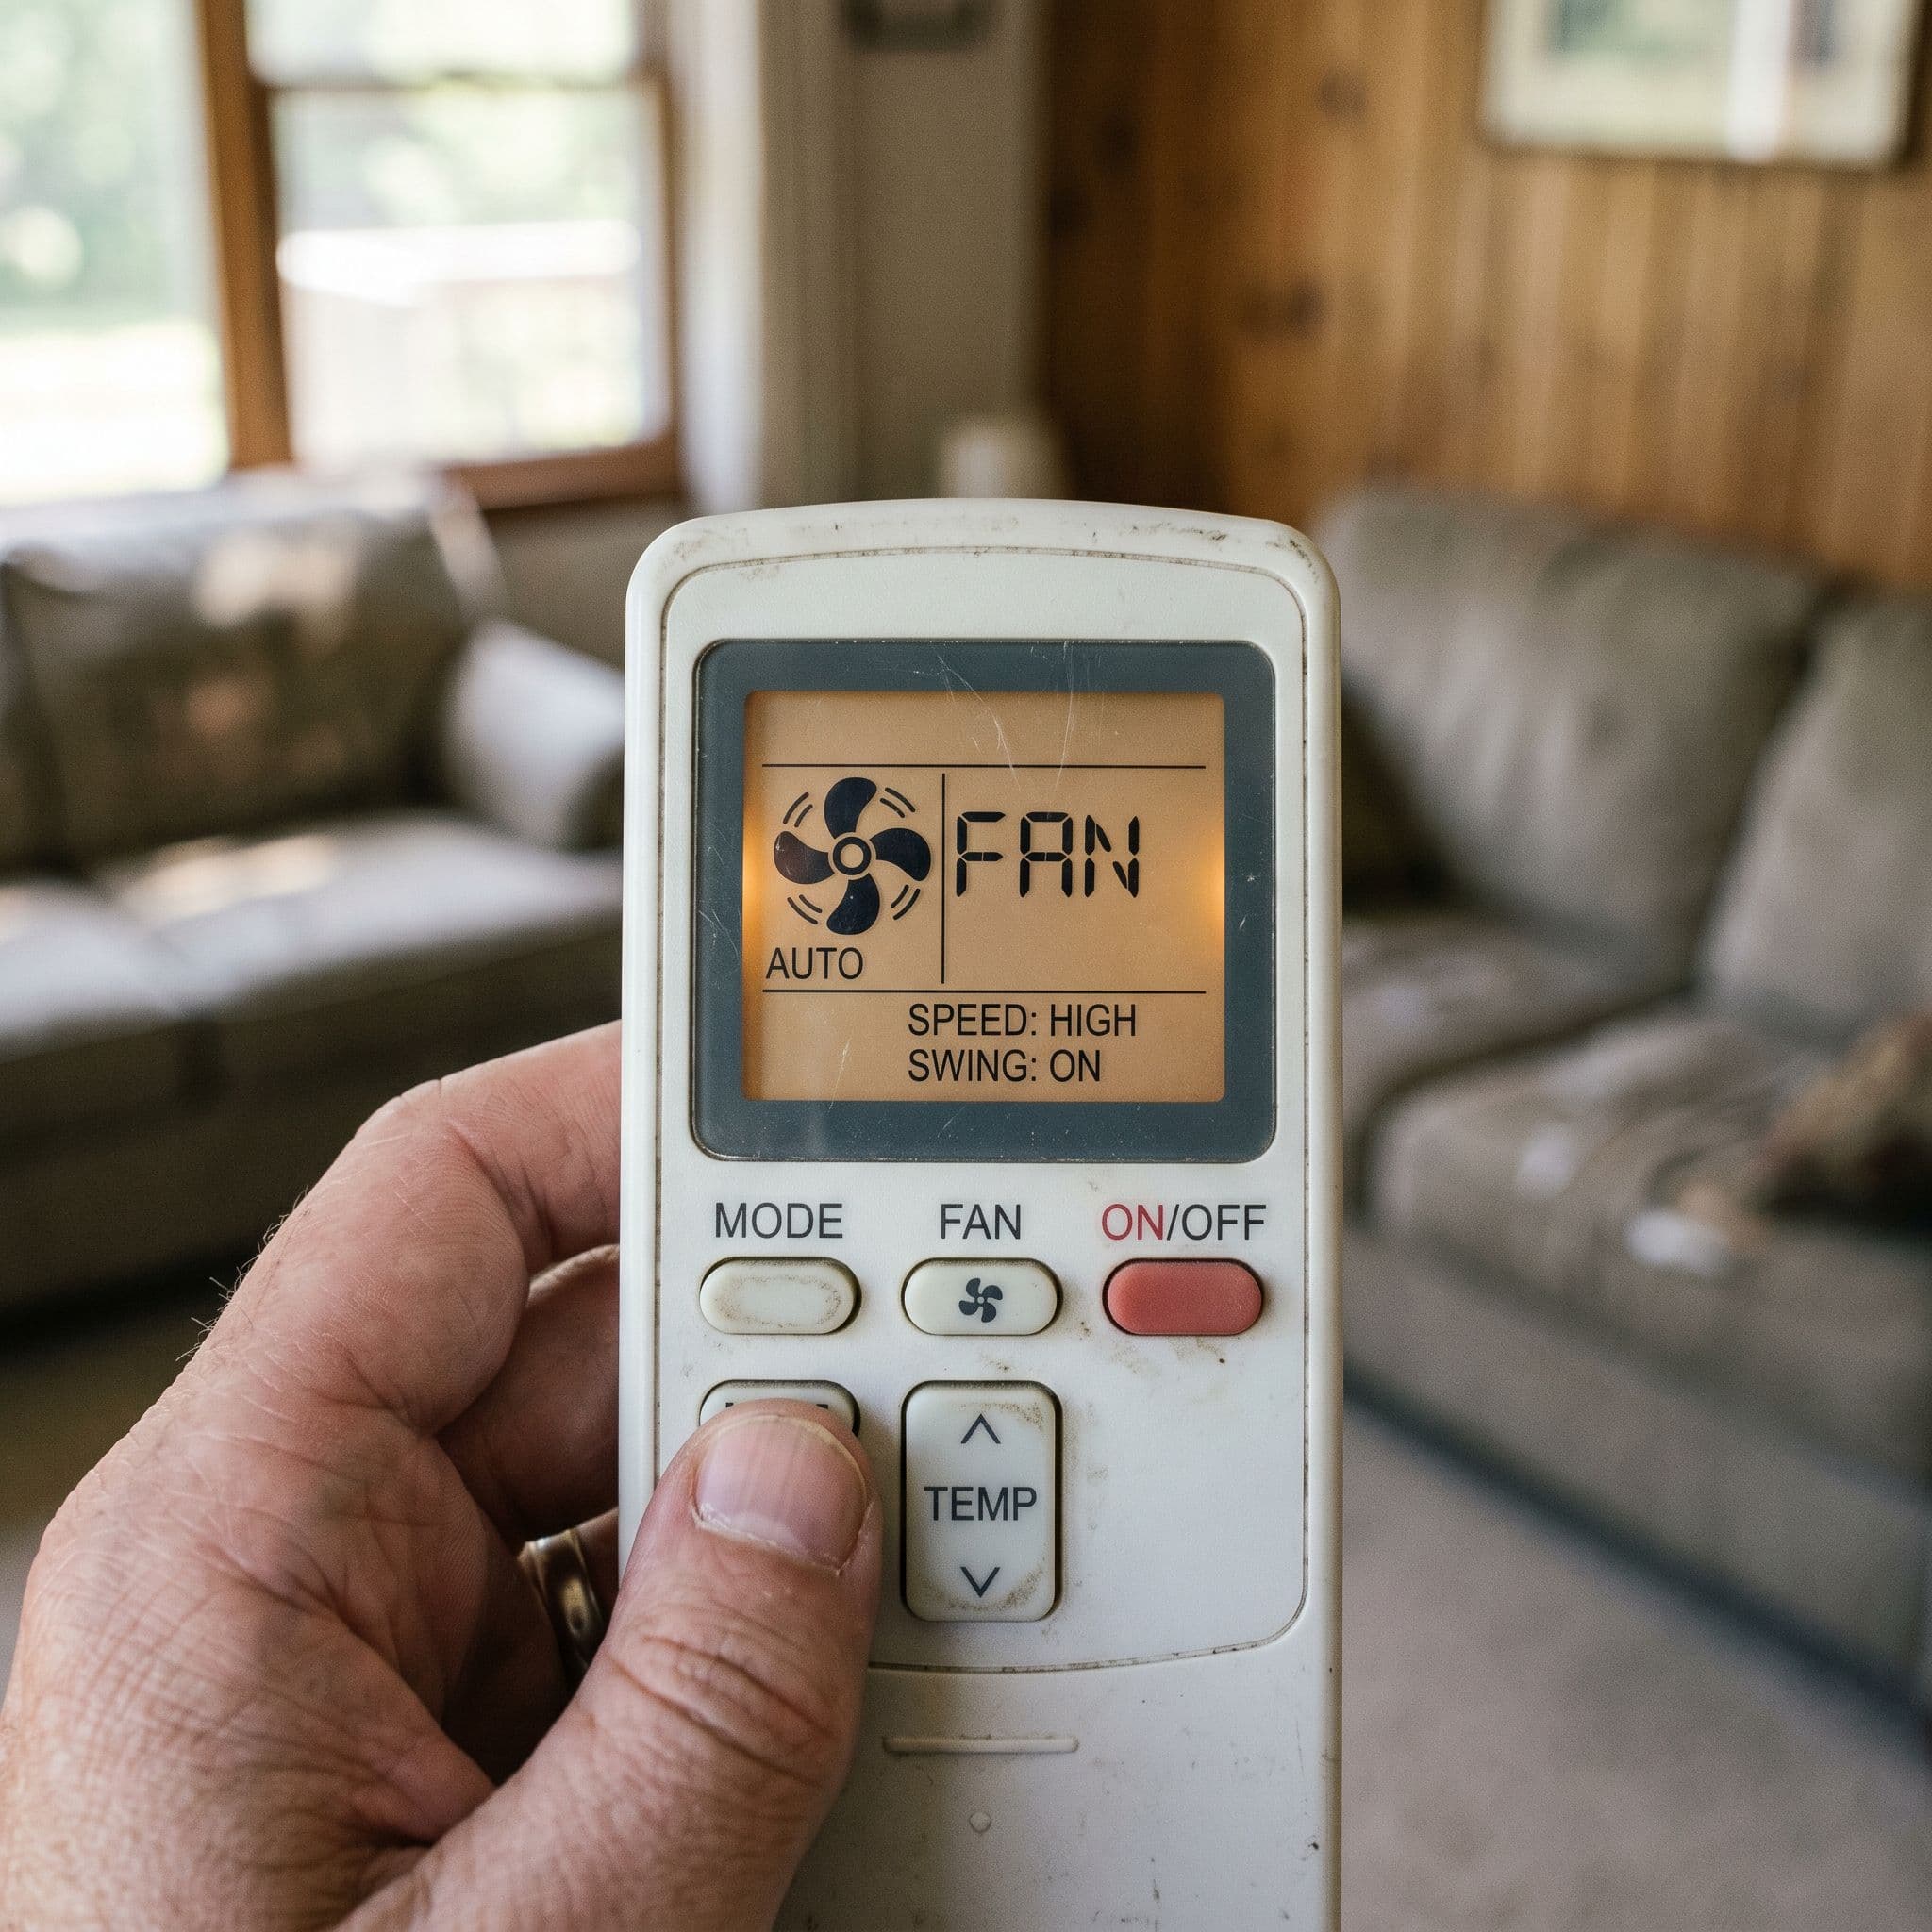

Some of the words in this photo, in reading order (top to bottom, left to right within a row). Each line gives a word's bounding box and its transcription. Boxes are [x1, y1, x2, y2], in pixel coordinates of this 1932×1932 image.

[956, 811, 1140, 898] FAN
[765, 946, 864, 980] AUTO
[908, 1003, 1037, 1037] SPEED:
[1050, 1003, 1136, 1037] HIGH
[908, 1048, 1037, 1083] SWING:
[1049, 1048, 1101, 1083] ON
[715, 1202, 843, 1240] MODE
[941, 1203, 1022, 1240] FAN
[1101, 1203, 1267, 1241] ON/OFF
[924, 1486, 1037, 1522] TEMP
